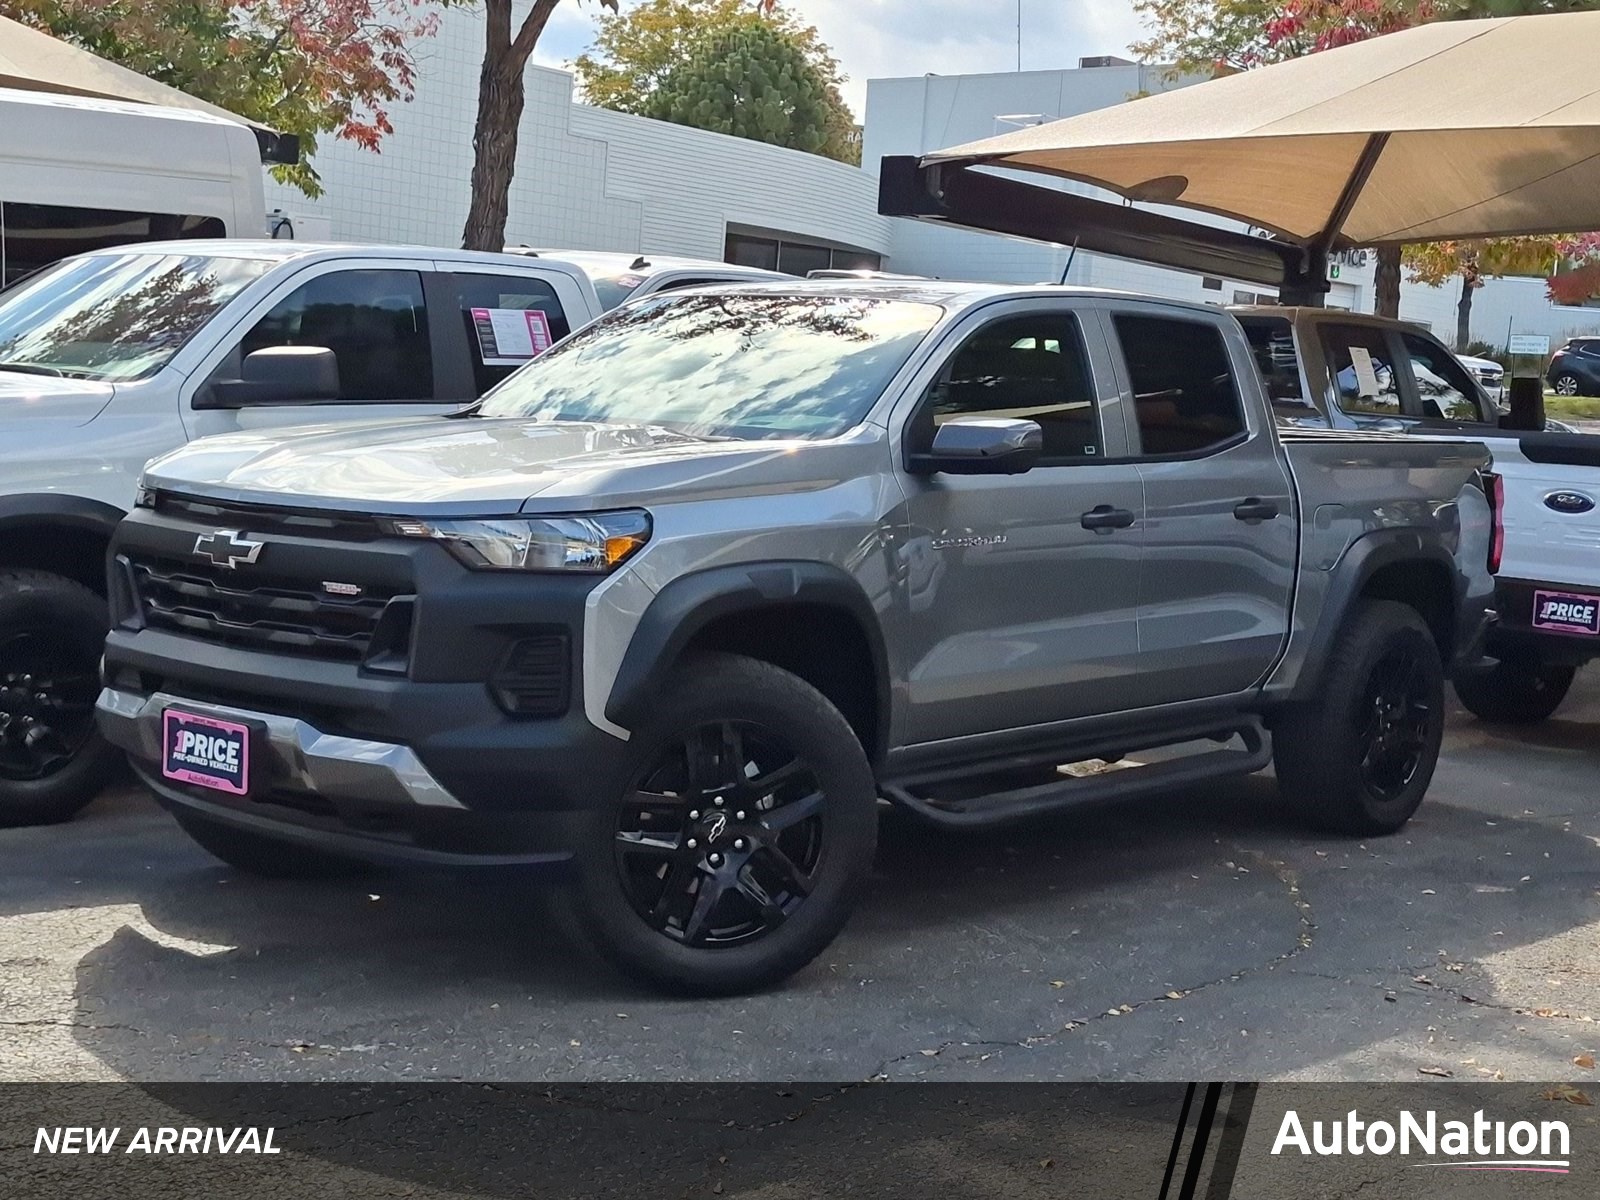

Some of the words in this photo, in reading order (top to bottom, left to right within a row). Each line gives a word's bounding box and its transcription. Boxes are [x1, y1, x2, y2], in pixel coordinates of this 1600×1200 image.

[1541, 601, 1595, 620] 1PRICE
[174, 729, 240, 765] 1PRICE
[172, 751, 208, 767] PRE-OWNED
[209, 760, 238, 774] VEHICLES
